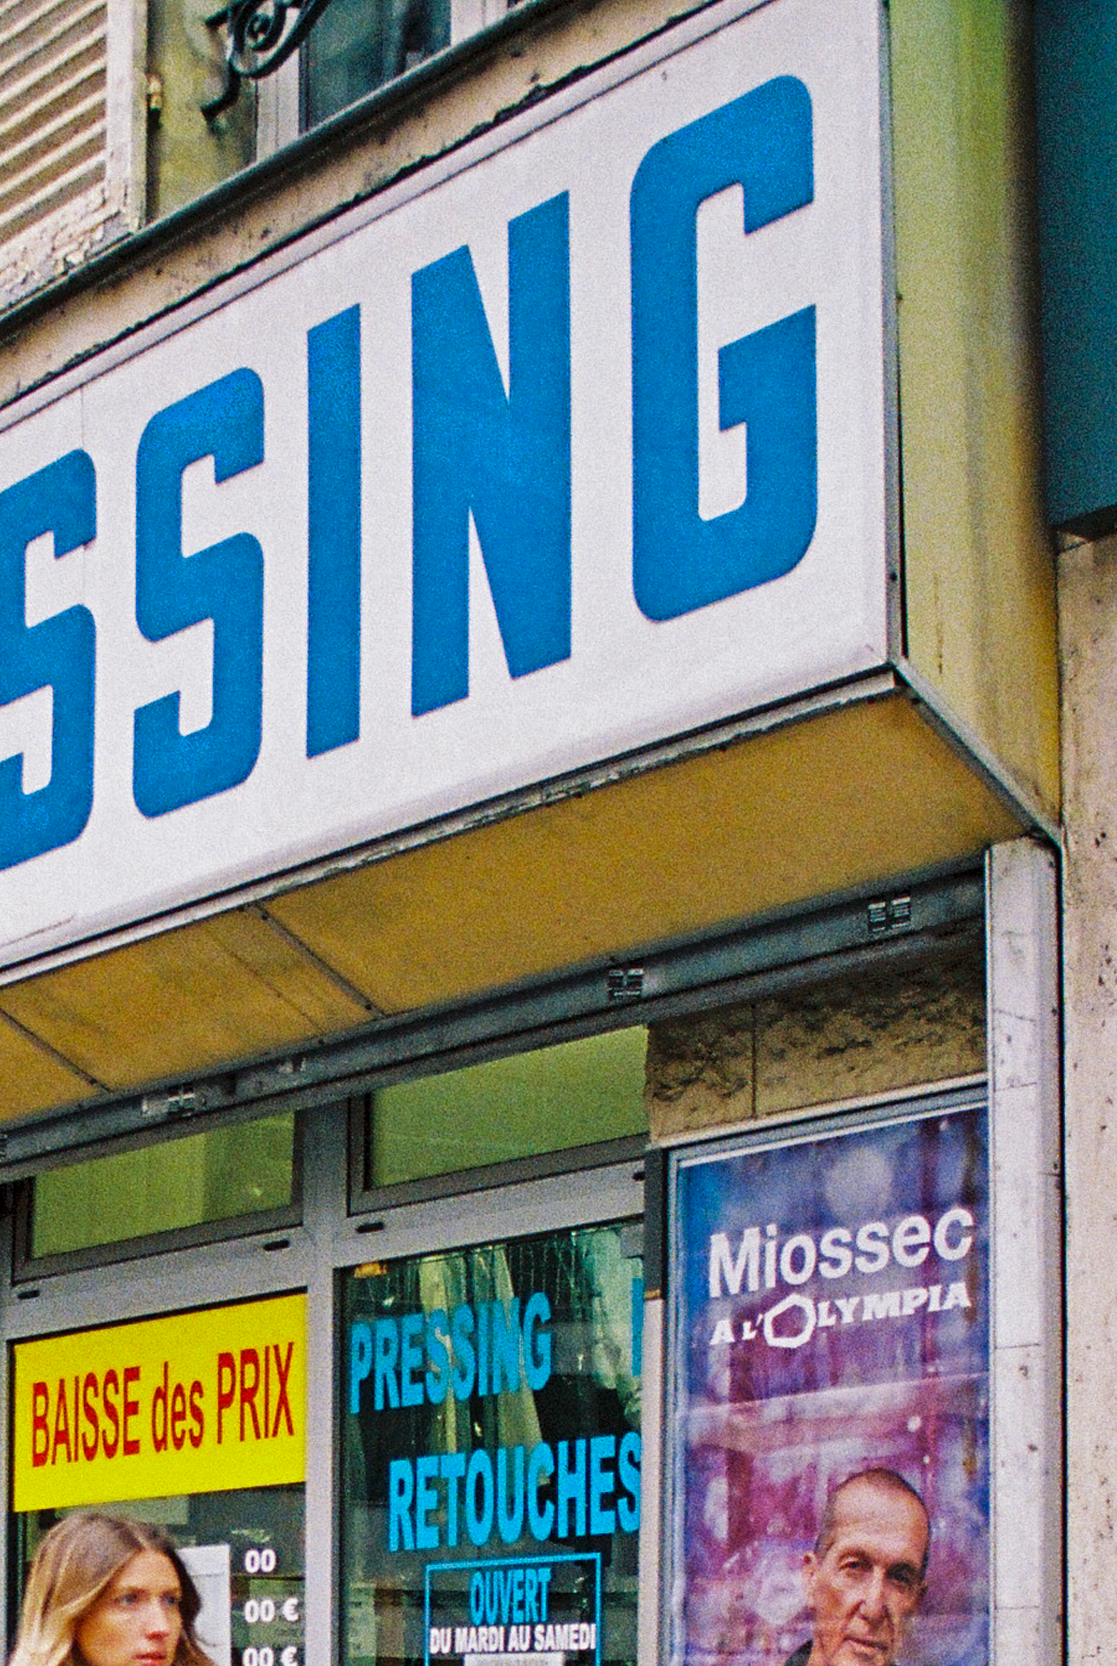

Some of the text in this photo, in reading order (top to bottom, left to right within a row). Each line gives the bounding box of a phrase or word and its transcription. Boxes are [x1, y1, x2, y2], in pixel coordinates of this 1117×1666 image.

[709, 1208, 974, 1299] Miossec
[350, 1293, 552, 1413] PRESSING
[709, 1317, 735, 1346] A
[32, 1342, 295, 1468] BAISSE des PRIX
[389, 1432, 641, 1551] RETOUCHES
[245, 1549, 277, 1573] 00
[471, 1568, 552, 1626] OUVERT
[429, 1623, 597, 1655] DU MARDI AU SAMEDI
